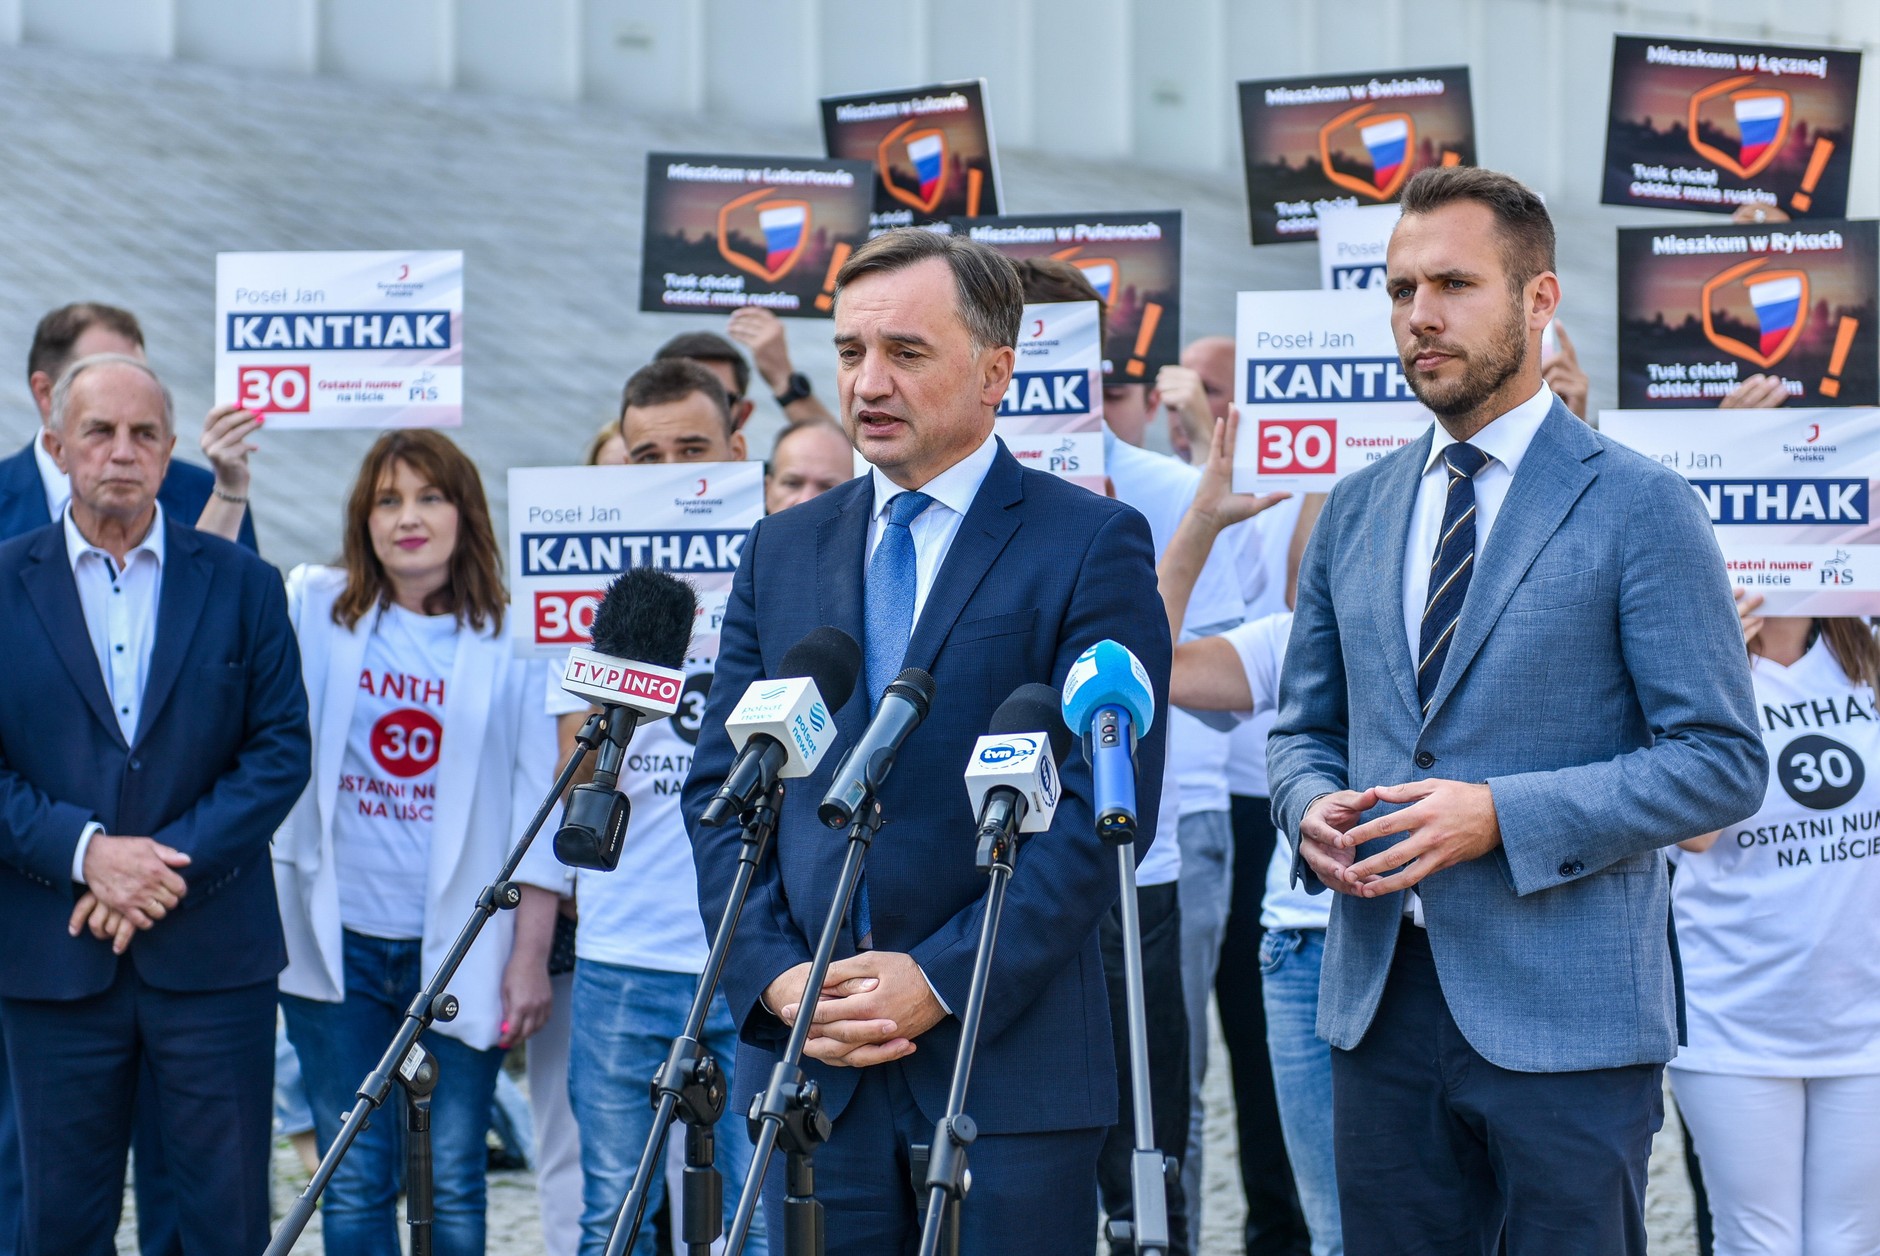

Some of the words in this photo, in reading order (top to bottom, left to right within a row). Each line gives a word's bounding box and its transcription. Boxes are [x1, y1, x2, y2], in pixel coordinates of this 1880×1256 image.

[1646, 45, 1737, 69] Mieszkam
[1738, 54, 1757, 70] w
[1350, 84, 1368, 99] w
[1632, 163, 1670, 182] Tusk
[1056, 226, 1074, 242] w
[1653, 234, 1748, 255] Mieszkam
[1749, 235, 1769, 252] w
[1770, 230, 1843, 253] Rykach
[235, 287, 288, 304] Poseł
[293, 287, 325, 304] Jan
[233, 314, 446, 348] KANTHAK
[1257, 331, 1313, 349] Poseł
[1319, 331, 1354, 349] Jan
[1647, 363, 1687, 380] Tusk
[1688, 361, 1738, 379] chciał
[241, 369, 306, 410] 30
[1254, 363, 1415, 399] KANTH
[1647, 380, 1701, 398] oddać
[337, 393, 352, 401] na
[409, 387, 438, 401] PiS
[1262, 424, 1332, 470] 30
[1345, 435, 1394, 447] Ostatni
[1783, 444, 1837, 453] Suwerenna
[1050, 456, 1079, 471] PiS
[1686, 450, 1722, 469] Jan
[1793, 453, 1825, 462] Polska
[1696, 483, 1862, 520] NTHAK
[529, 506, 582, 523] Poseł
[588, 506, 621, 523] Jan
[528, 534, 747, 572] KANTHAK
[1727, 559, 1766, 570] statni
[1769, 561, 1813, 570] numer
[1737, 575, 1753, 584] na
[1757, 573, 1791, 585] liście
[1820, 567, 1854, 585] PiS
[358, 668, 445, 706] ANTH
[573, 661, 620, 685] TVP
[624, 673, 676, 699] INFO
[1761, 693, 1878, 732] NTHA
[380, 723, 436, 762] 30
[792, 727, 810, 760] news
[795, 714, 817, 755] polsat
[1790, 748, 1853, 794] 30
[339, 773, 406, 798] STATNI
[653, 779, 682, 796] NA
[358, 799, 388, 818] NA
[393, 800, 433, 823] LIŚC
[1736, 816, 1834, 849] OSTATNI
[1777, 848, 1812, 868] NA
